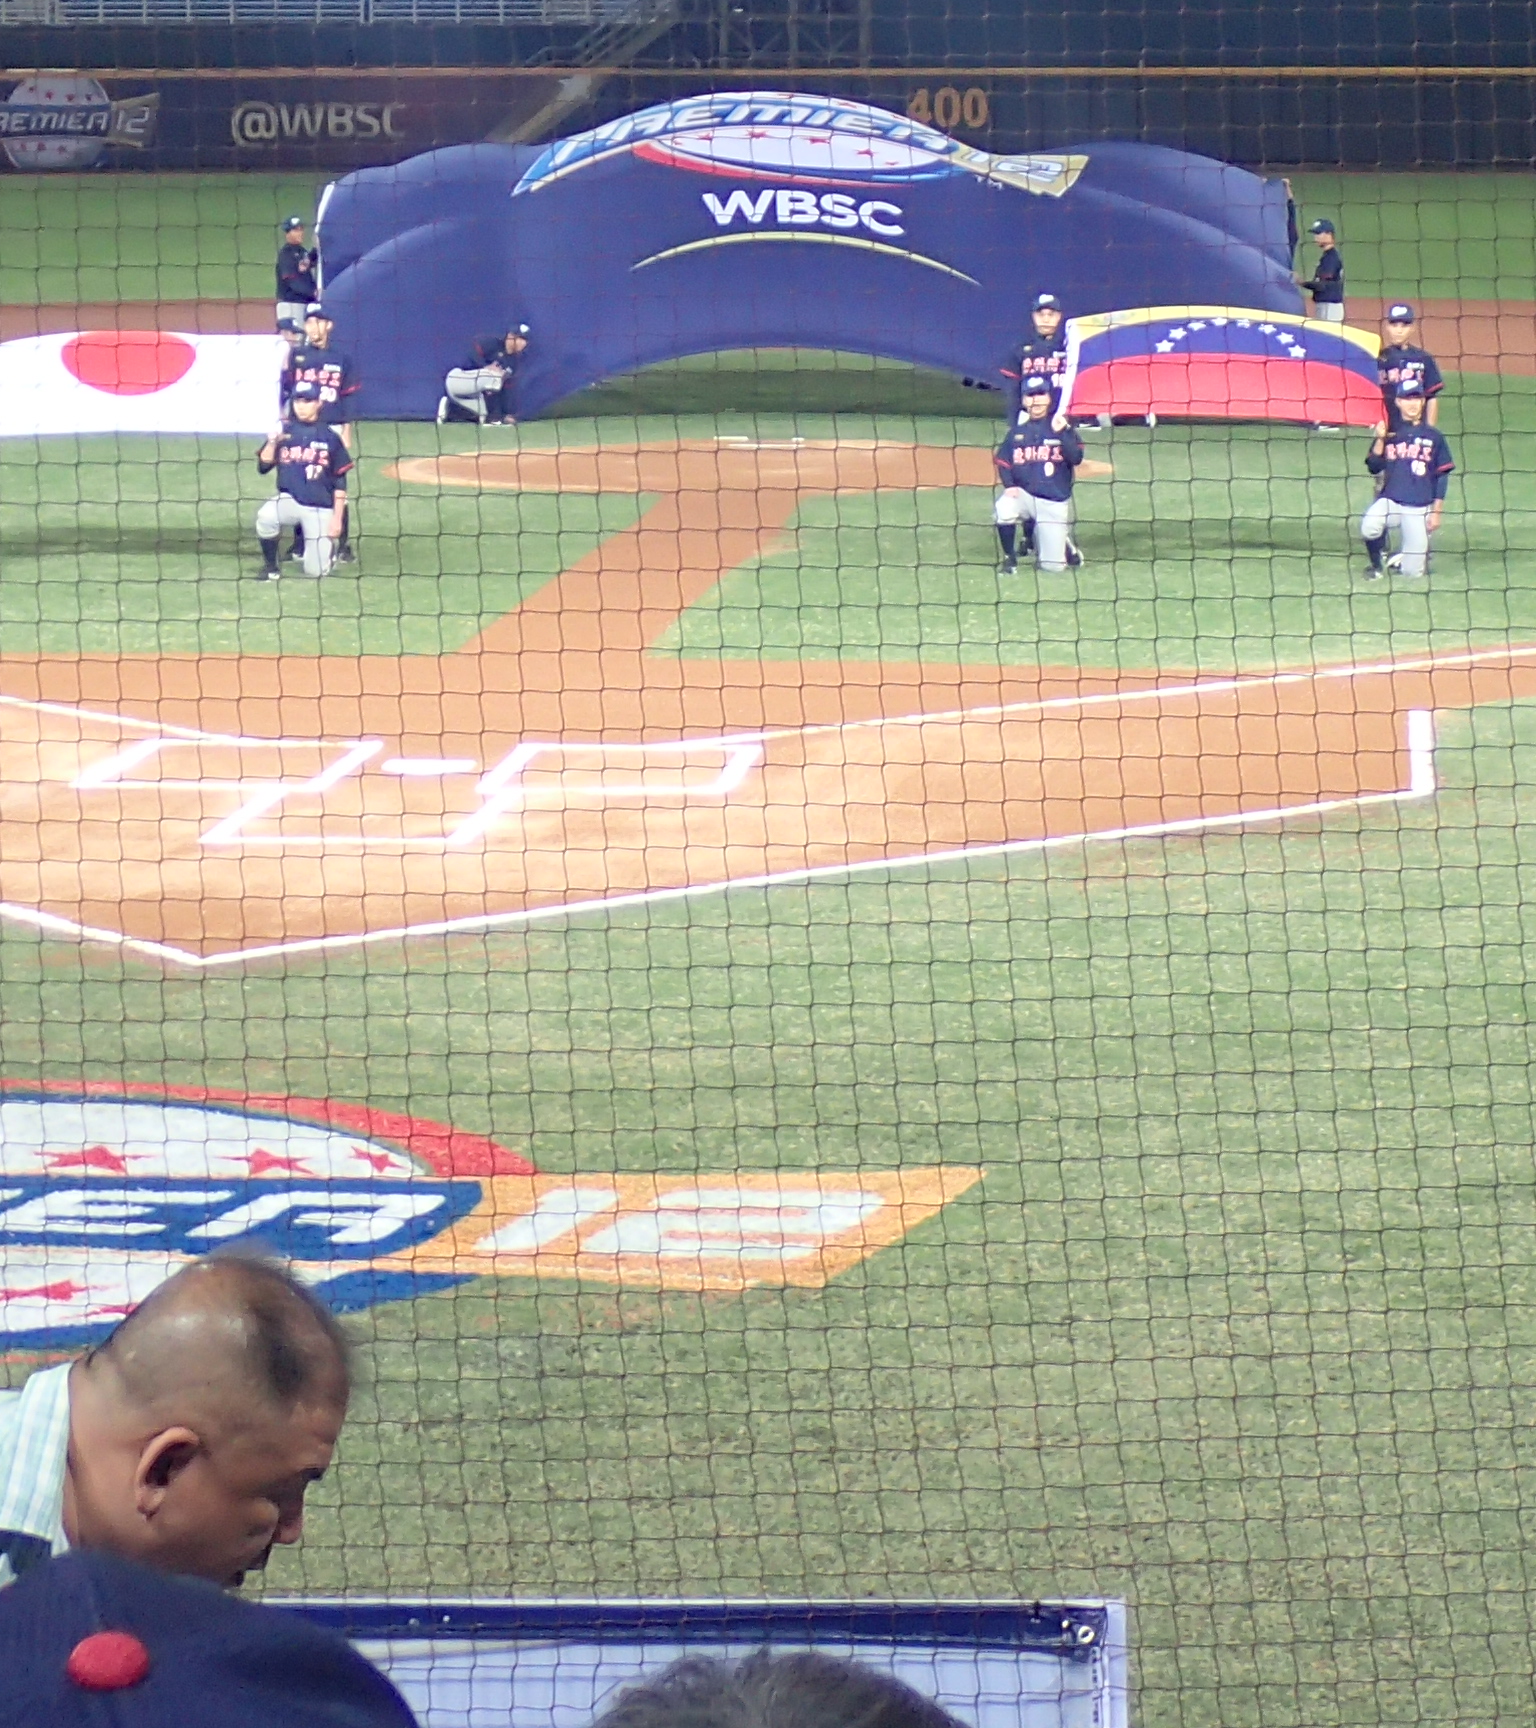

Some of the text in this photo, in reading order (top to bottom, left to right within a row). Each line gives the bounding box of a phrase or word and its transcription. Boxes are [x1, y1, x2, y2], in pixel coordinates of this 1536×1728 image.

[115, 106, 151, 134] 12
[231, 100, 407, 149] @WBSC
[907, 87, 989, 129] 400
[702, 189, 905, 236] WBSC
